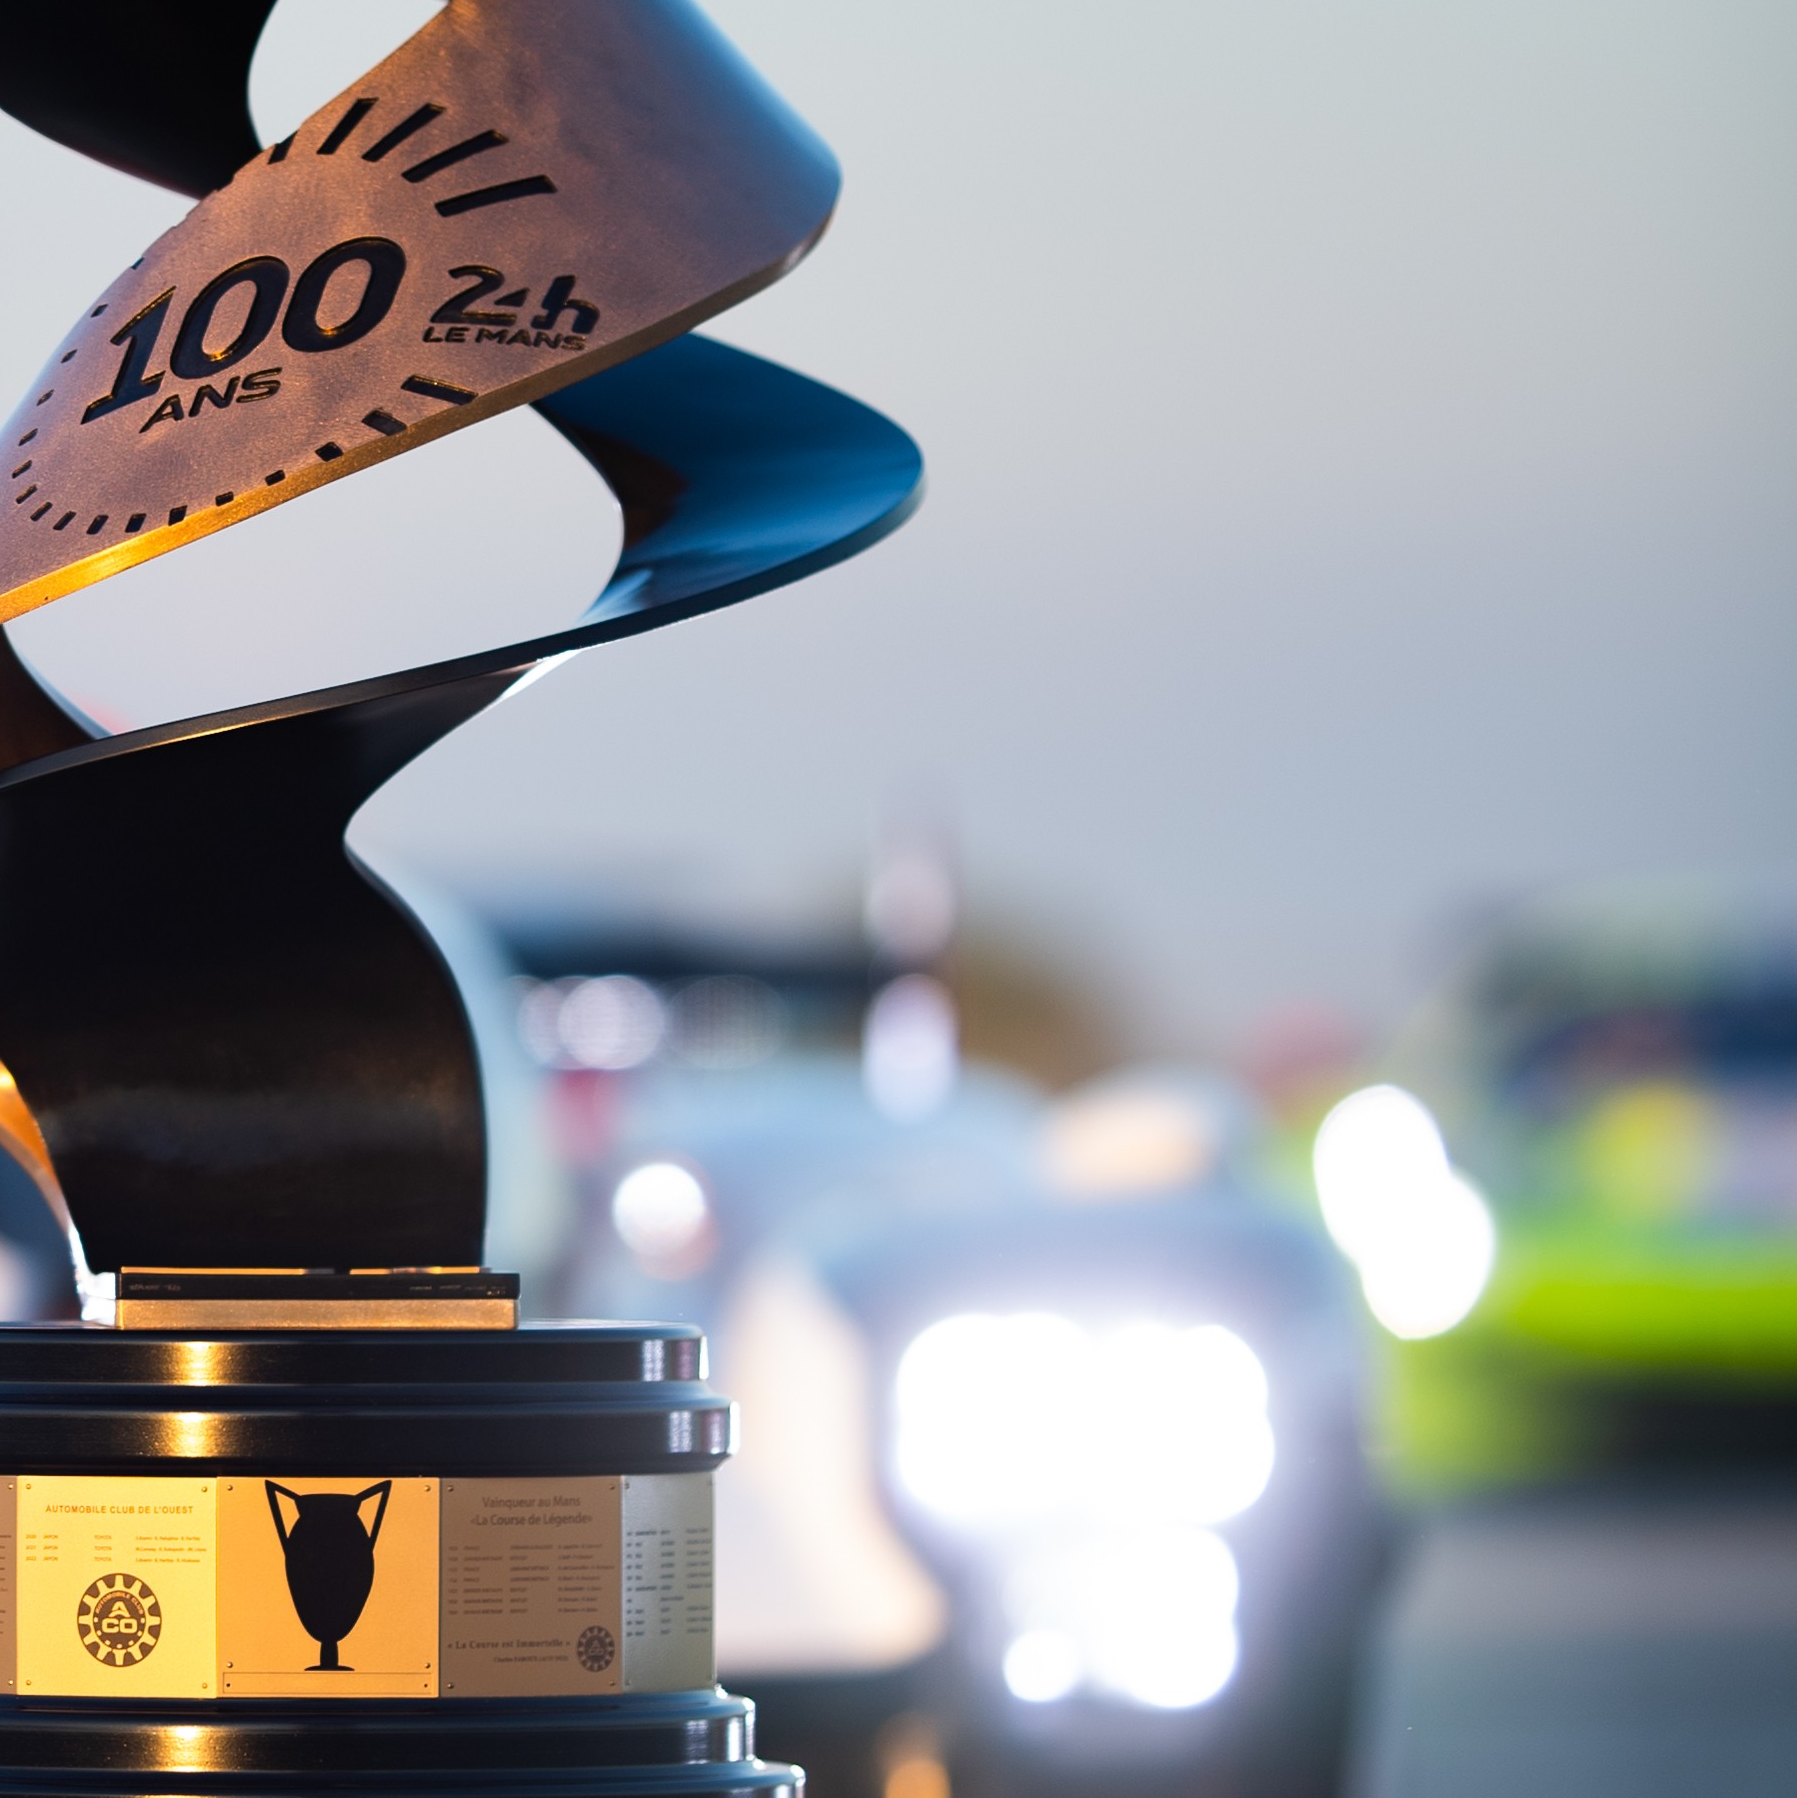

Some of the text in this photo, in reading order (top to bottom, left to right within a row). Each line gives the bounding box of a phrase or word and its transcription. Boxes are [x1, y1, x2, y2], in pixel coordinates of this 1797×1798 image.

[429, 264, 600, 335] 24h
[80, 236, 407, 425] 100
[422, 326, 587, 352] LE MANS
[139, 367, 283, 434] ANS
[45, 1505, 194, 1514] AUTOMOBILE CLUB DE L'OUEST
[482, 1495, 581, 1510] Vainqueur au Mans
[490, 1515, 526, 1526] Course
[528, 1514, 541, 1525] de
